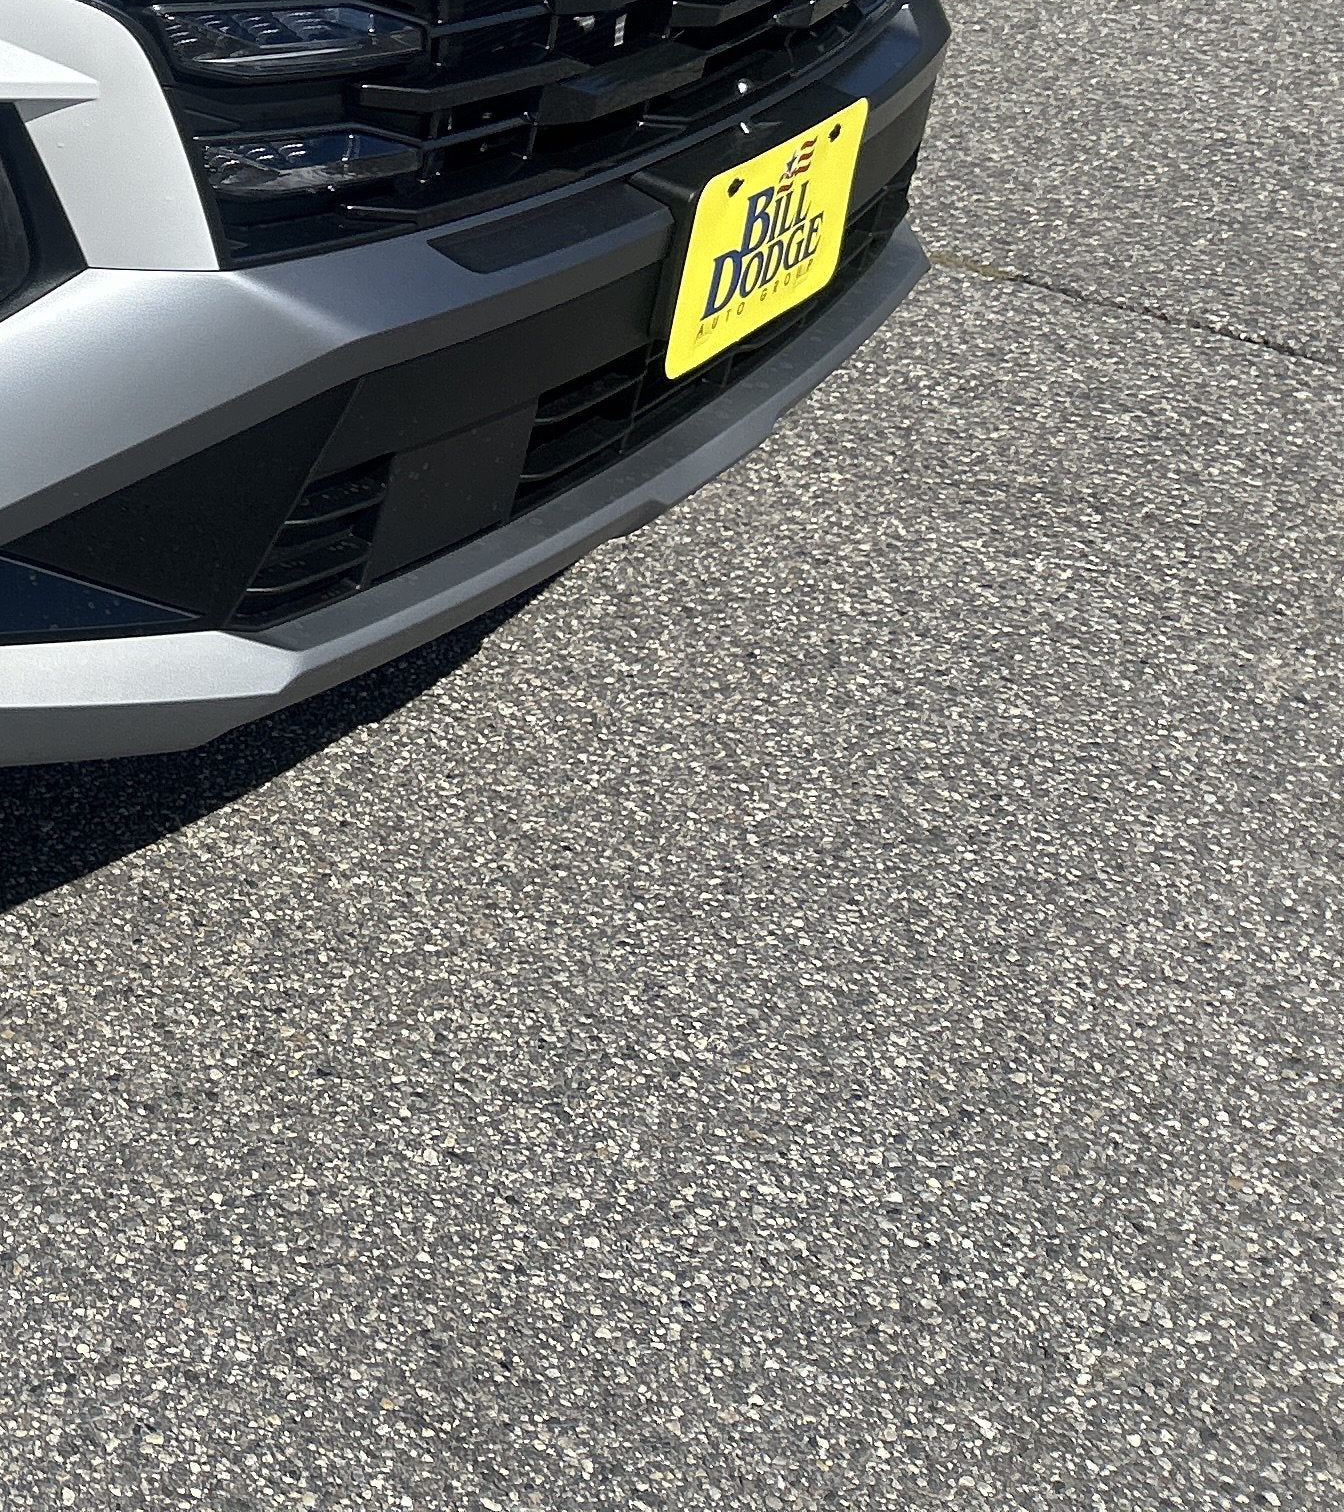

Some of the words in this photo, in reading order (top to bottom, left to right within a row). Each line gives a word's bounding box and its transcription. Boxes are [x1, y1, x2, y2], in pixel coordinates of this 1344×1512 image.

[740, 180, 811, 256] BILL
[700, 211, 825, 321] DODGE
[695, 301, 745, 340] AUTO
